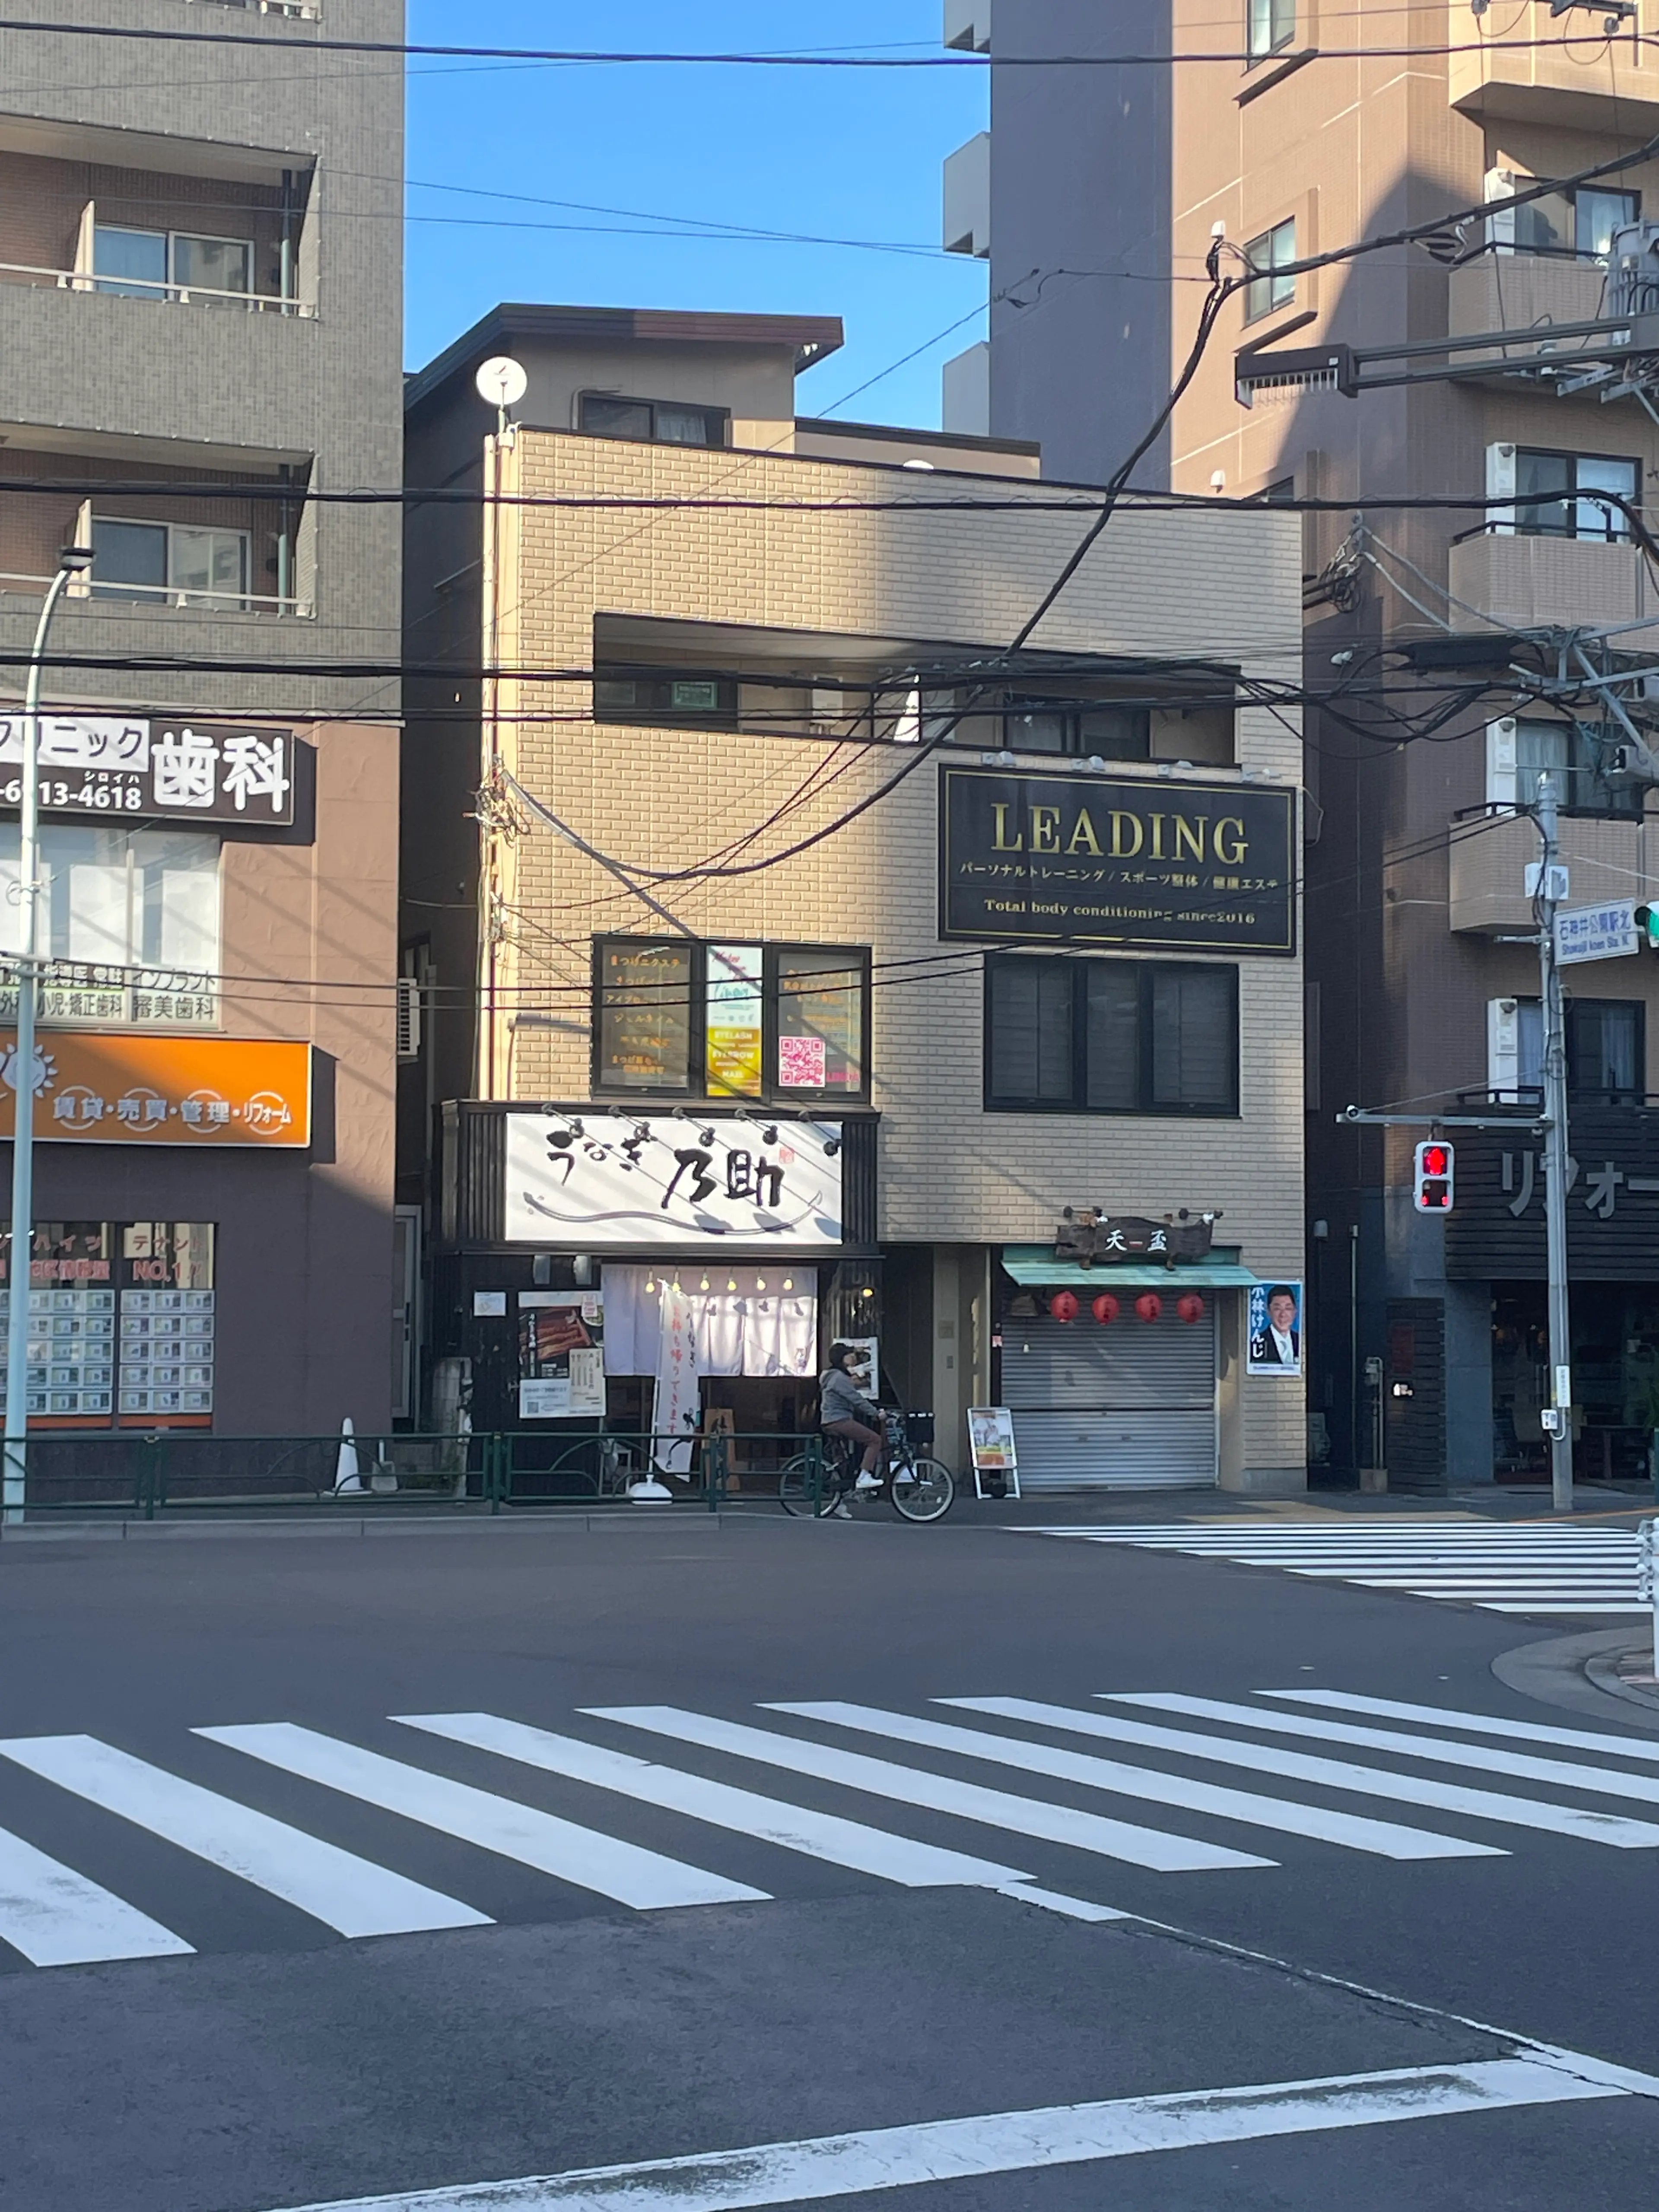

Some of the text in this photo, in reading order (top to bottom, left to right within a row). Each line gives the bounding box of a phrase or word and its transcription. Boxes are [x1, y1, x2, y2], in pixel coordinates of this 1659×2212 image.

[84, 770, 140, 784] シロイハ
[151, 728, 290, 813] 歯科
[0, 779, 142, 810] -613-4618
[990, 803, 1249, 864] LEADING
[960, 861, 1105, 882] パーソナルトレーニング
[984, 899, 1026, 912] Total
[1031, 901, 1069, 917] body
[1073, 904, 1173, 922] conditioning
[1251, 1286, 1265, 1358] 小林けんじ
